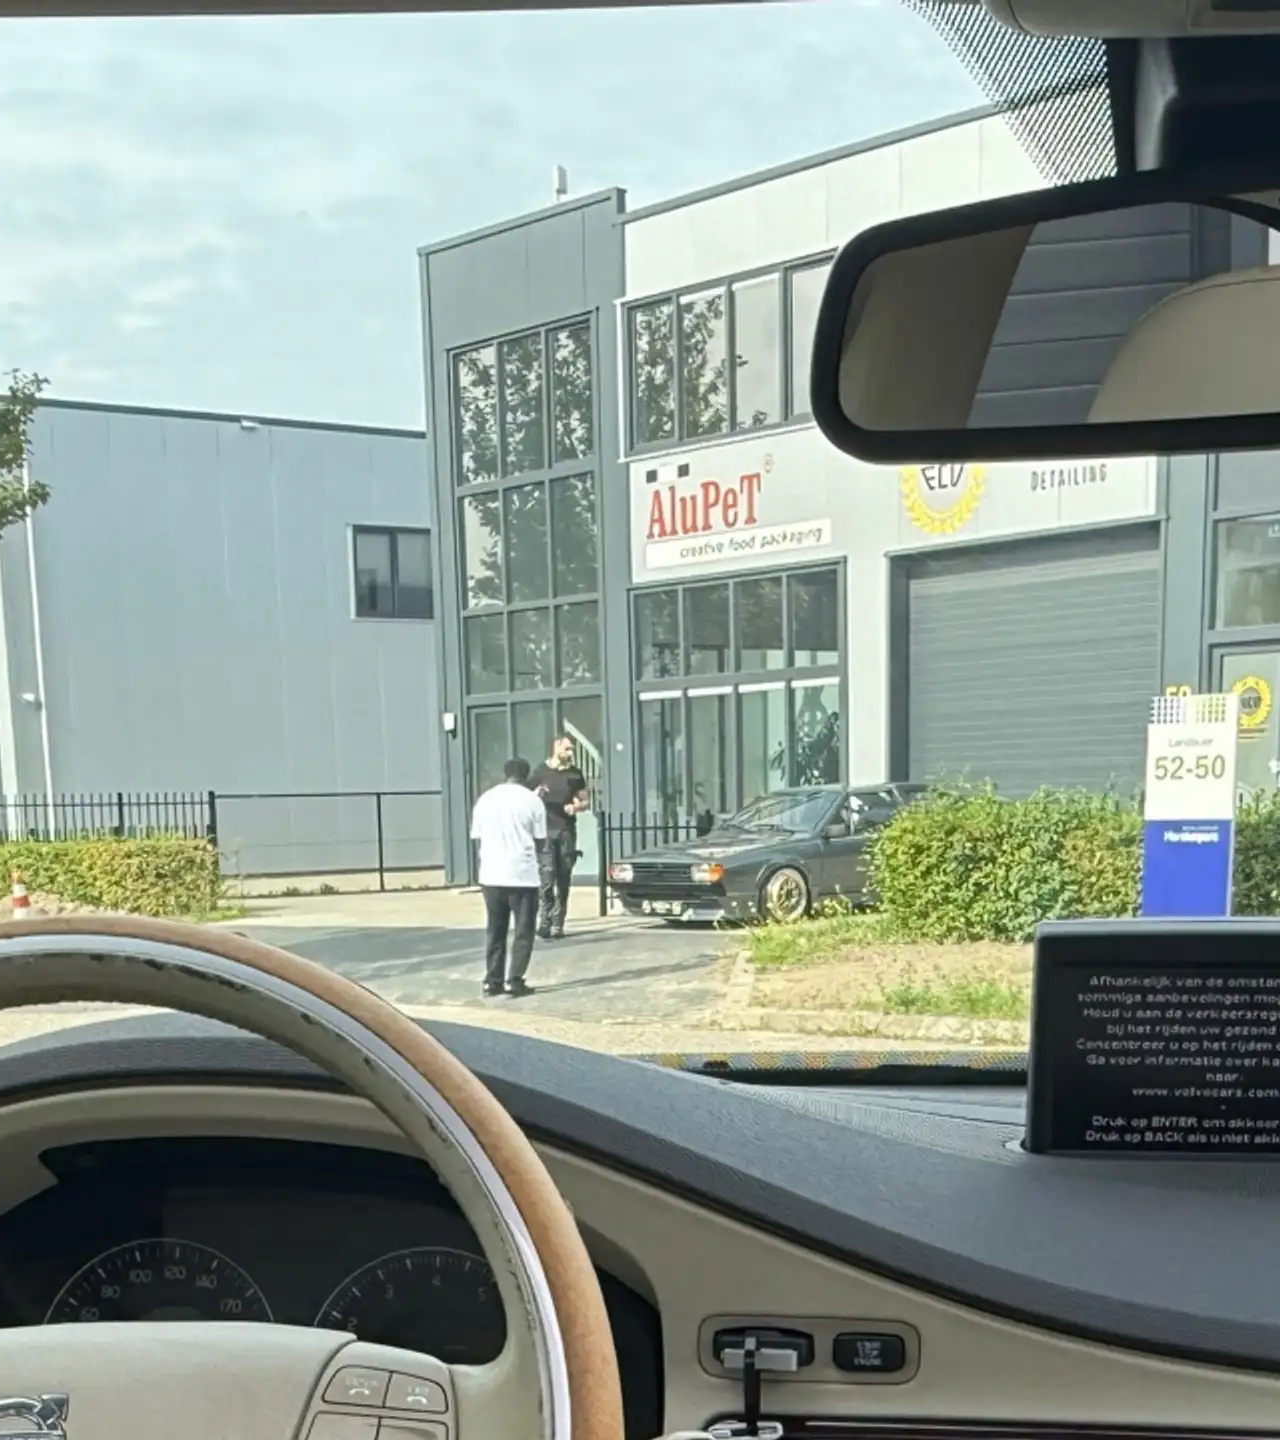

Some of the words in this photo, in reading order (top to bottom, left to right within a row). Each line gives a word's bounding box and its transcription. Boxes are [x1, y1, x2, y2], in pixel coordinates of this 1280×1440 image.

[1031, 463, 1108, 491] DETAILING
[646, 472, 762, 540] AluPeT
[729, 535, 756, 551] food
[760, 527, 823, 550] packaging
[1154, 754, 1226, 781] 52-50
[1089, 976, 1171, 989] Afhankelijk
[1176, 979, 1202, 988] van
[1205, 977, 1223, 988] de
[1078, 992, 1142, 1005] sommige
[1146, 992, 1250, 1005] aanbevelingen
[1083, 1007, 1119, 1019] Houd
[1122, 1009, 1132, 1018] u
[1136, 1009, 1162, 1019] aan
[1165, 1007, 1183, 1019] de
[1106, 1023, 1125, 1037] bij
[1127, 1023, 1151, 1035] het
[1155, 1024, 1197, 1037] rijden
[1199, 1026, 1221, 1035] uw
[1224, 1025, 1277, 1038] gezond
[1075, 1038, 1166, 1050] Concentreer
[1169, 1040, 1179, 1049] u
[1182, 1040, 1200, 1052] op
[1203, 1038, 1227, 1051] het
[1231, 1039, 1273, 1053] rijden
[1086, 1054, 1106, 1066] Ga
[1109, 1056, 1142, 1066] voor
[1144, 1054, 1222, 1067] informatie
[1225, 1057, 1258, 1067] over
[1092, 1115, 1127, 1127] Druk
[1130, 1117, 1149, 1129] op
[1151, 1116, 1199, 1128] ENTER
[1202, 1118, 1226, 1129] om
[1085, 1130, 1121, 1142] Druk
[1124, 1133, 1141, 1144] op
[1144, 1131, 1184, 1143] BACK
[1187, 1131, 1208, 1144] als
[1210, 1133, 1220, 1144] u
[1222, 1132, 1251, 1145] niet
[128, 1269, 152, 1284] 100
[100, 1284, 120, 1299] 80
